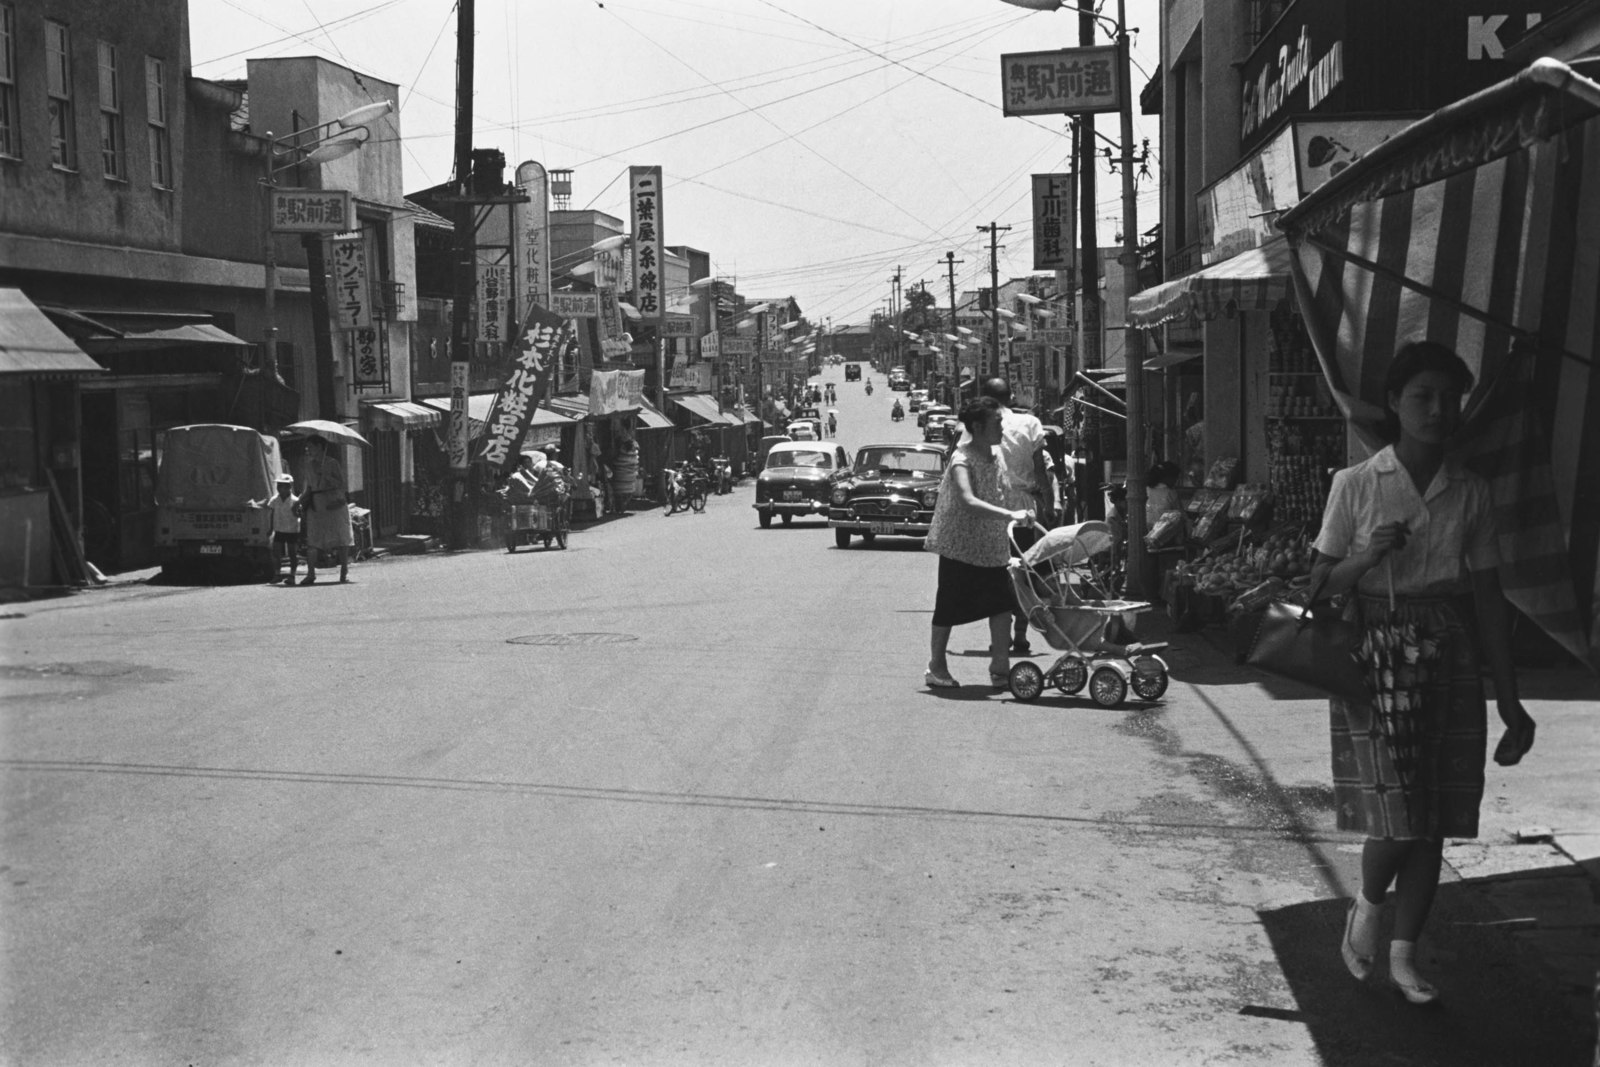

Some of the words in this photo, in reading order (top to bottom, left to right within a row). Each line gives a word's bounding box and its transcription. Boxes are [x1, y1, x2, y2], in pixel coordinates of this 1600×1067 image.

[1041, 179, 1061, 257] 上川歯科
[480, 322, 553, 464] 杉本化粧品店
